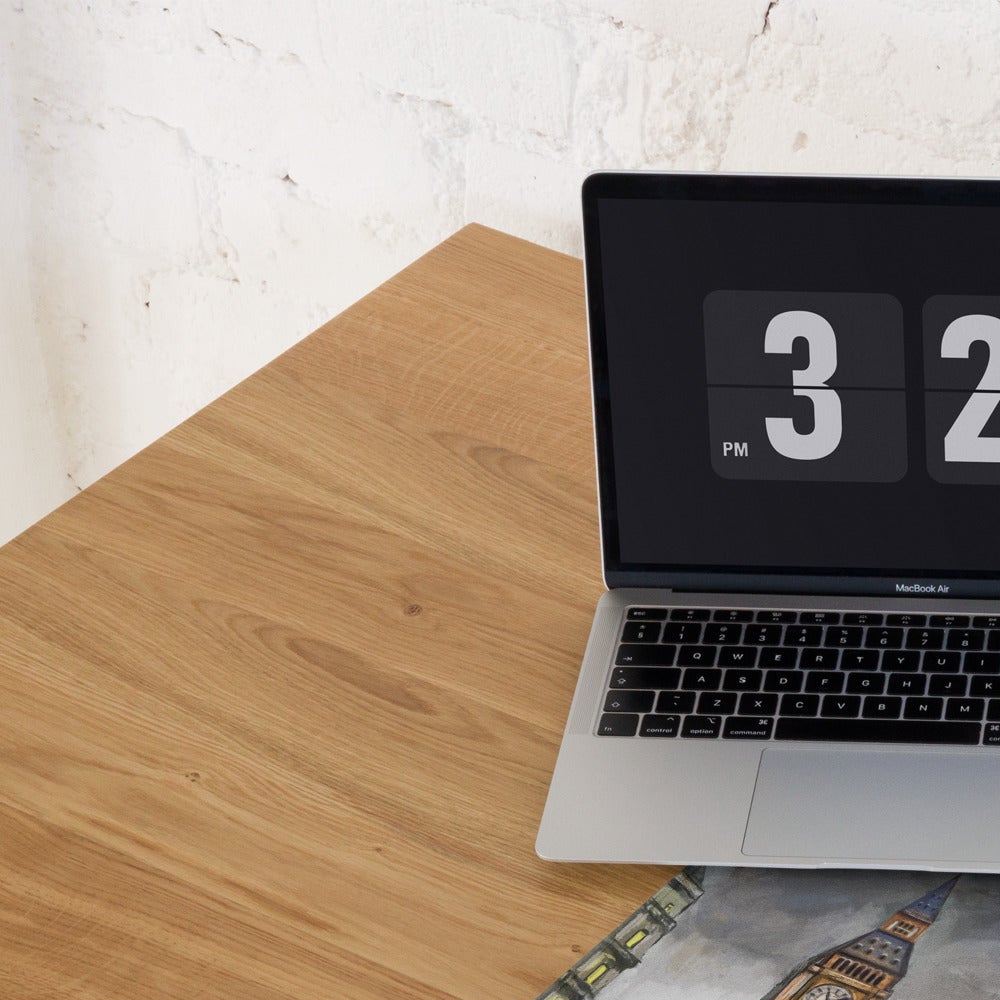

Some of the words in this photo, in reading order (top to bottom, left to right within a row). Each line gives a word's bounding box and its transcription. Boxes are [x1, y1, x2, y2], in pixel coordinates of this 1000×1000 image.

[764, 310, 842, 460] 3
[722, 442, 748, 457] PM
[896, 584, 936, 592] MacBook
[937, 584, 950, 593] Air
